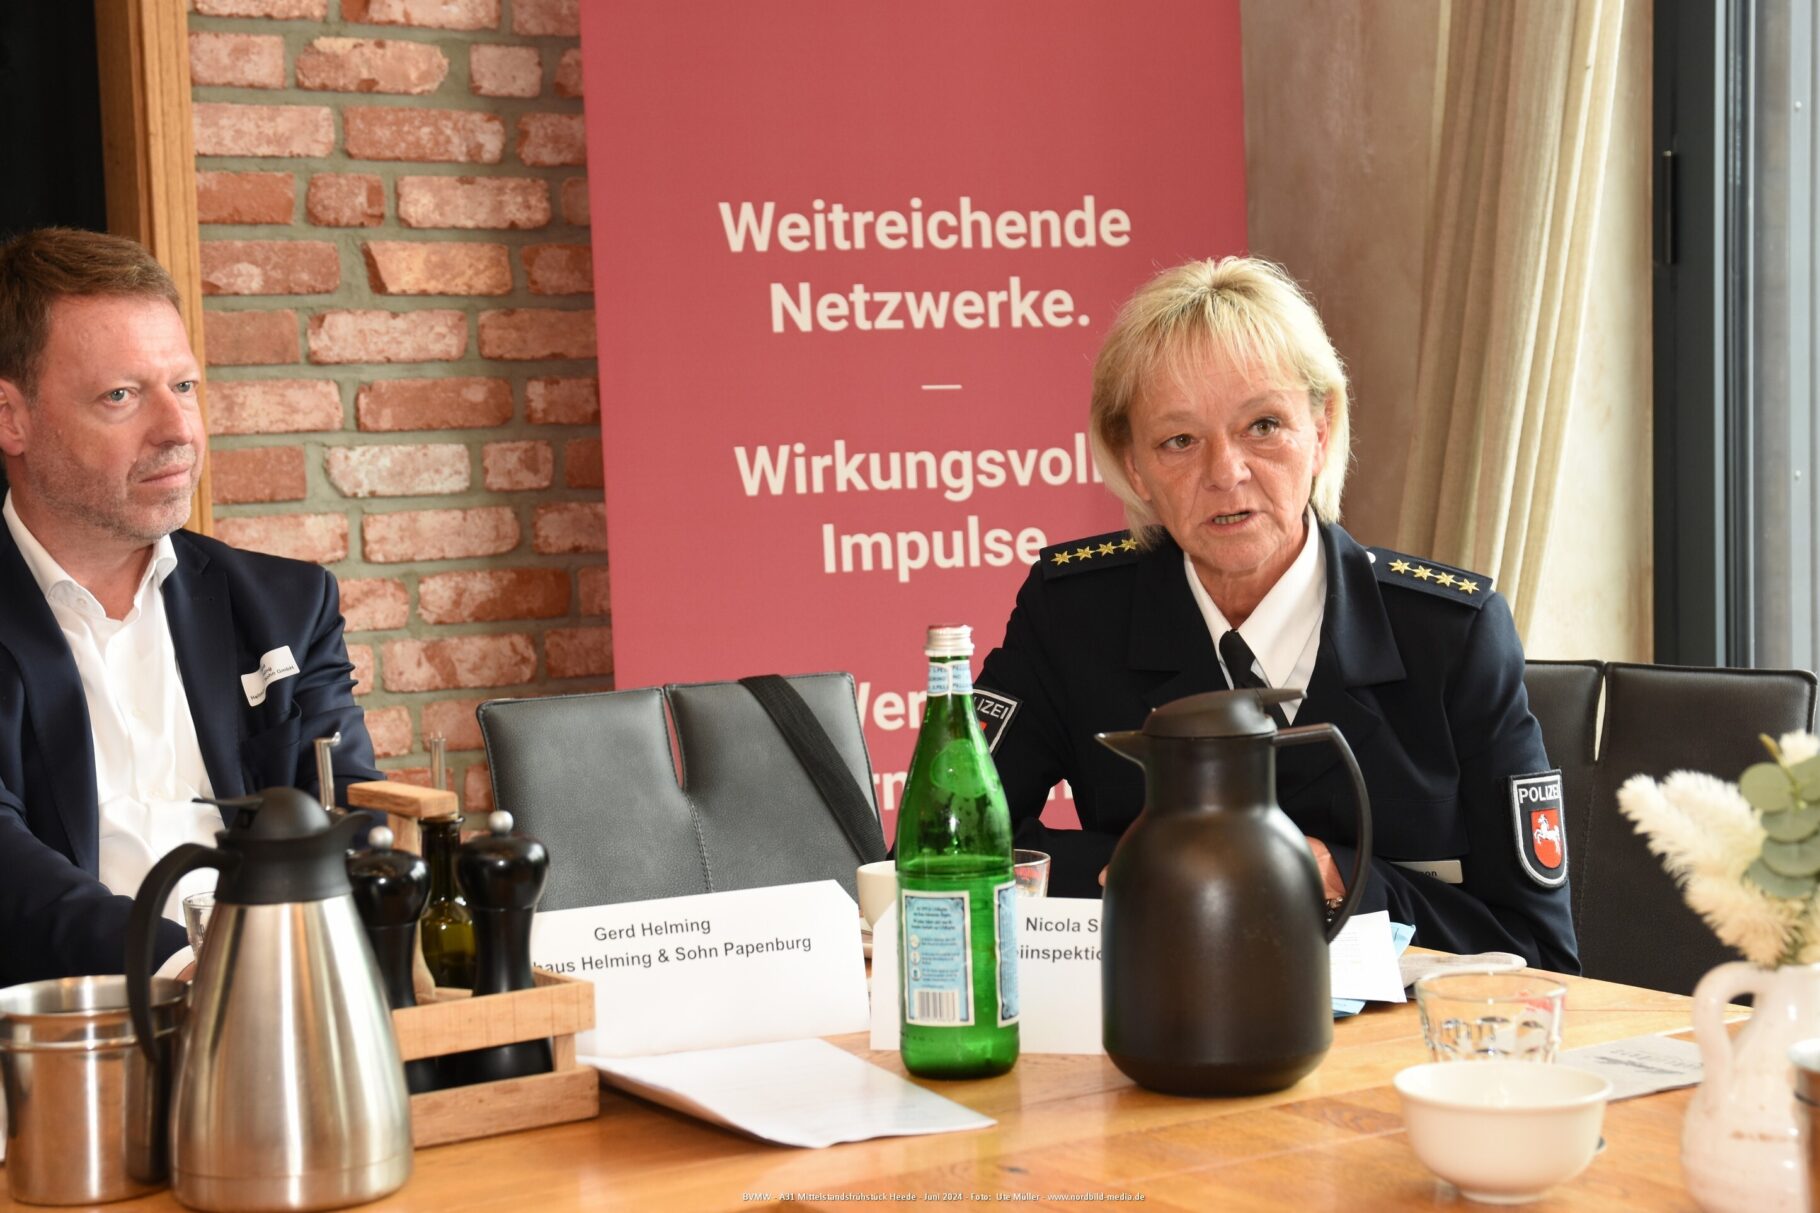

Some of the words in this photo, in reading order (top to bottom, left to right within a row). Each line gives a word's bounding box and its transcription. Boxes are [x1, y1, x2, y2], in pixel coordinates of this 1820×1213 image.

[718, 195, 1131, 253] Weitreichende
[769, 276, 1090, 333] Netzwerke.
[822, 515, 1048, 583] Impulse
[594, 924, 636, 942] Gerd
[640, 918, 712, 937] Helming
[1025, 916, 1081, 933] Nicola
[1087, 918, 1099, 933] S
[581, 952, 653, 972] Helming
[657, 948, 671, 965] &
[675, 944, 719, 962] Sohn
[723, 937, 812, 958] Papenburg
